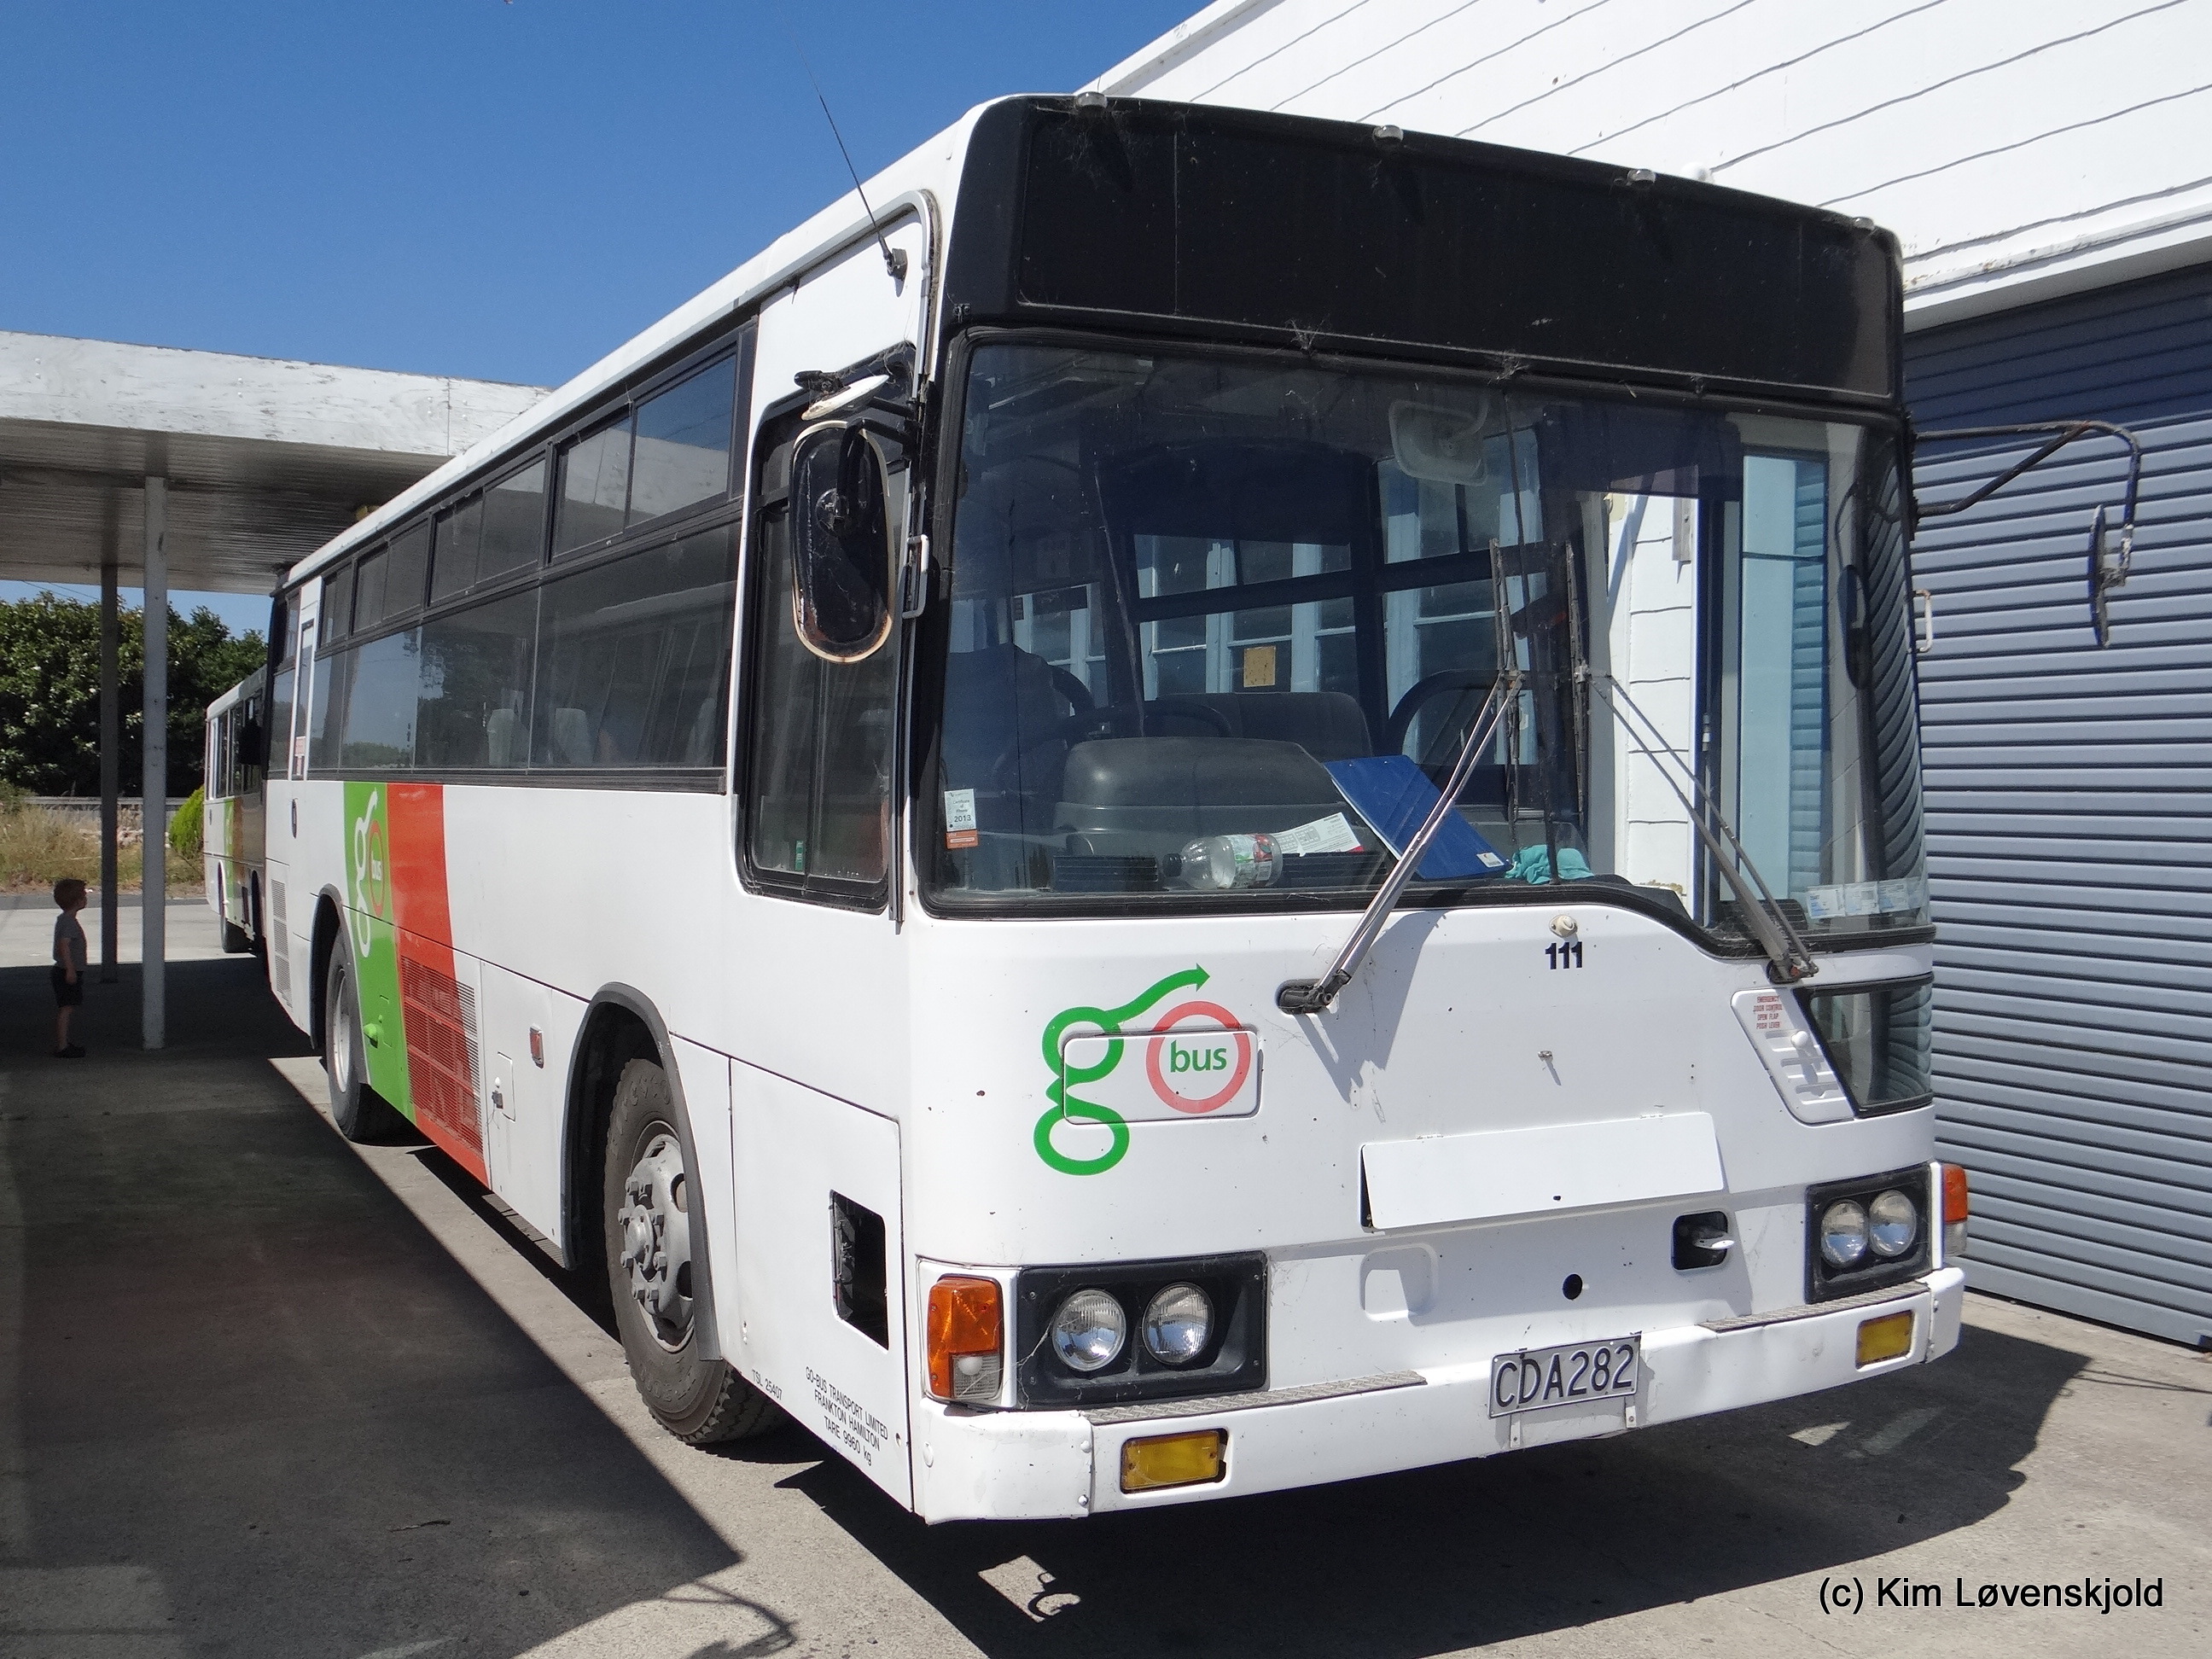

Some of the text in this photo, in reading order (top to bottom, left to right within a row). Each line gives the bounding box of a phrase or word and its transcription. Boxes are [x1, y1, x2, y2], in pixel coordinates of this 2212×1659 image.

[954, 814, 972, 823] 2013
[1545, 941, 1582, 969] 111
[1170, 1039, 1227, 1073] bus
[752, 1369, 783, 1401] TSL 25407
[1494, 1343, 1634, 1408] CDA282
[806, 1366, 888, 1441] GO-BUS TRANSPORT LIMITED
[814, 1388, 881, 1452] FRANKTON HAMILTON
[824, 1415, 872, 1467] TARE 9960 kg
